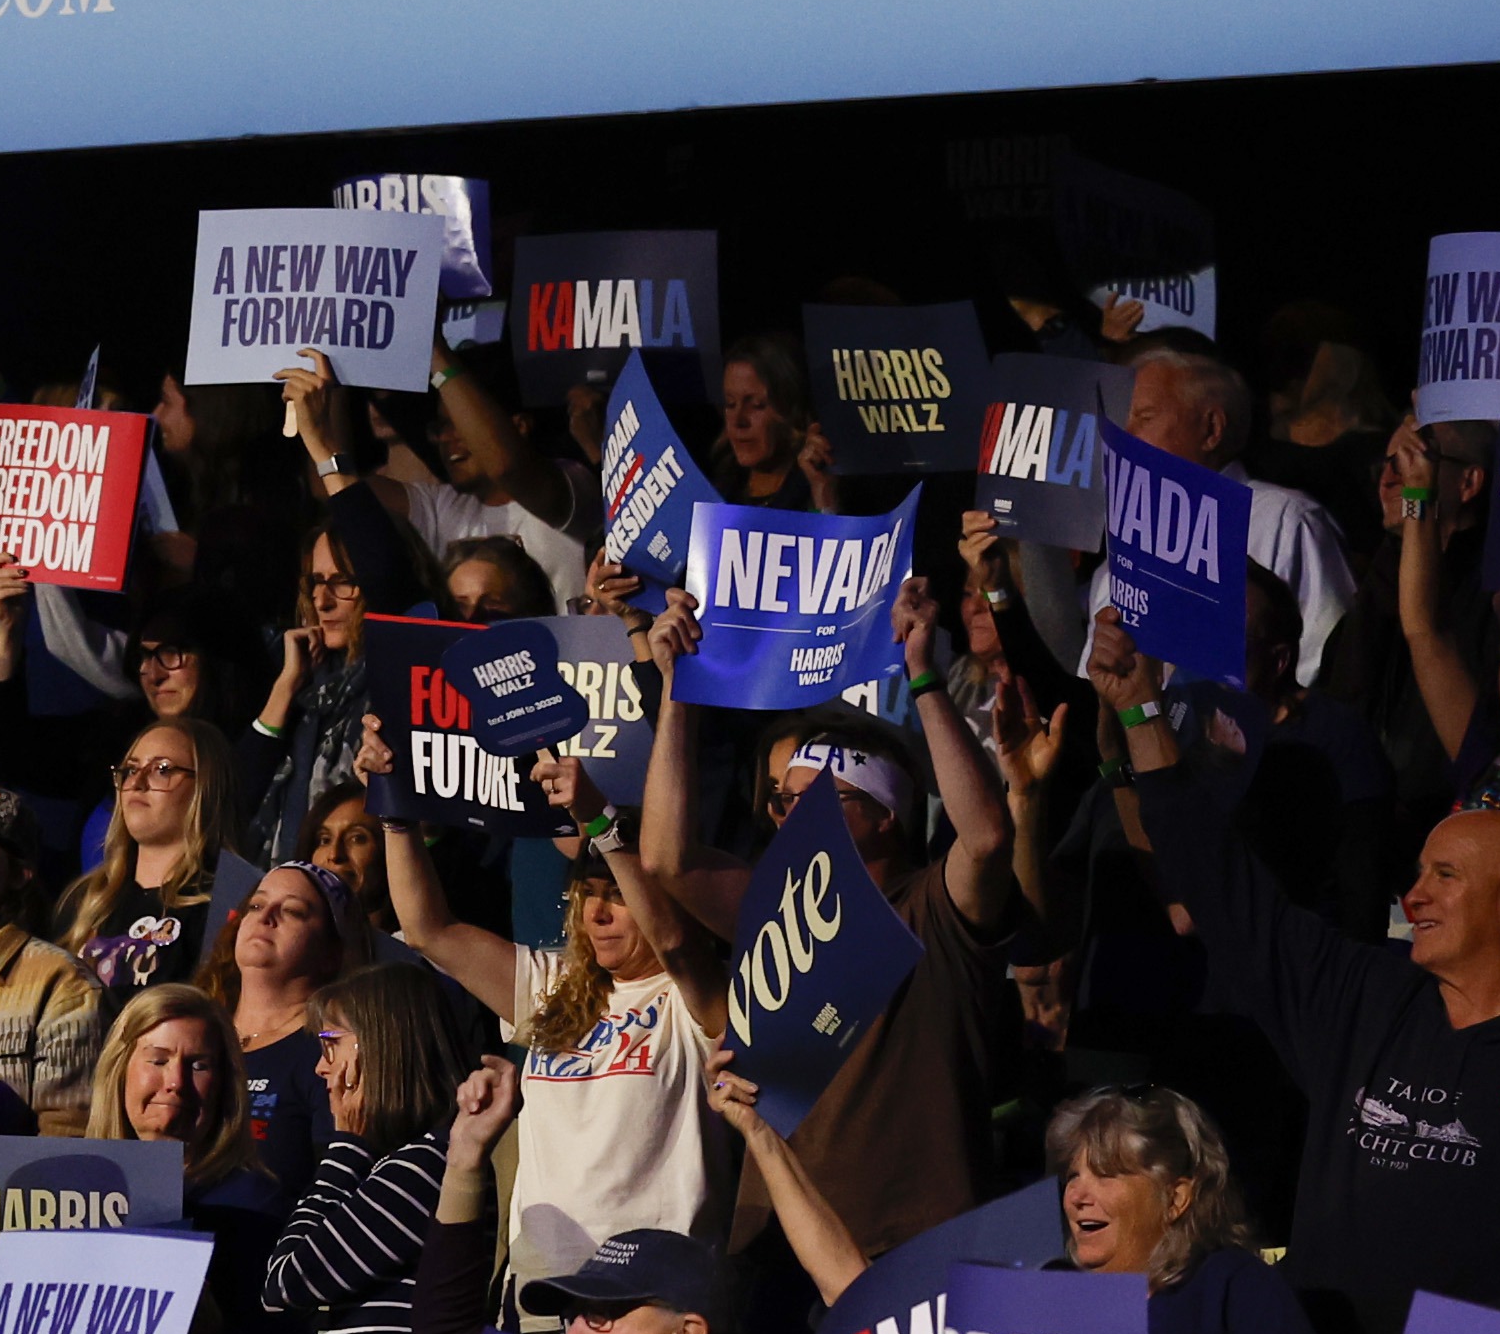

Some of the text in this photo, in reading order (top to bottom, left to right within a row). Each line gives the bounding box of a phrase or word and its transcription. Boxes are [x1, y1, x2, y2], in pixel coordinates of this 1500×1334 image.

[214, 245, 417, 298] A NEW WAY
[222, 298, 395, 350] FORWARD
[528, 279, 696, 351] KAMALA
[832, 346, 951, 401] HARRIS
[858, 403, 944, 434] WALZ
[714, 522, 903, 615] NEVADA
[1117, 554, 1132, 570] FOR
[816, 626, 836, 636] FOR
[472, 649, 536, 688] HARRIS
[790, 643, 845, 675] HARRIS
[797, 666, 834, 685] WALZ
[491, 674, 534, 697] WALZ
[505, 708, 526, 721] JOIN
[411, 731, 525, 811] FUTURE
[727, 851, 841, 1048] vote
[608, 1032, 654, 1073] 24
[1409, 1144, 1477, 1166] CLUB
